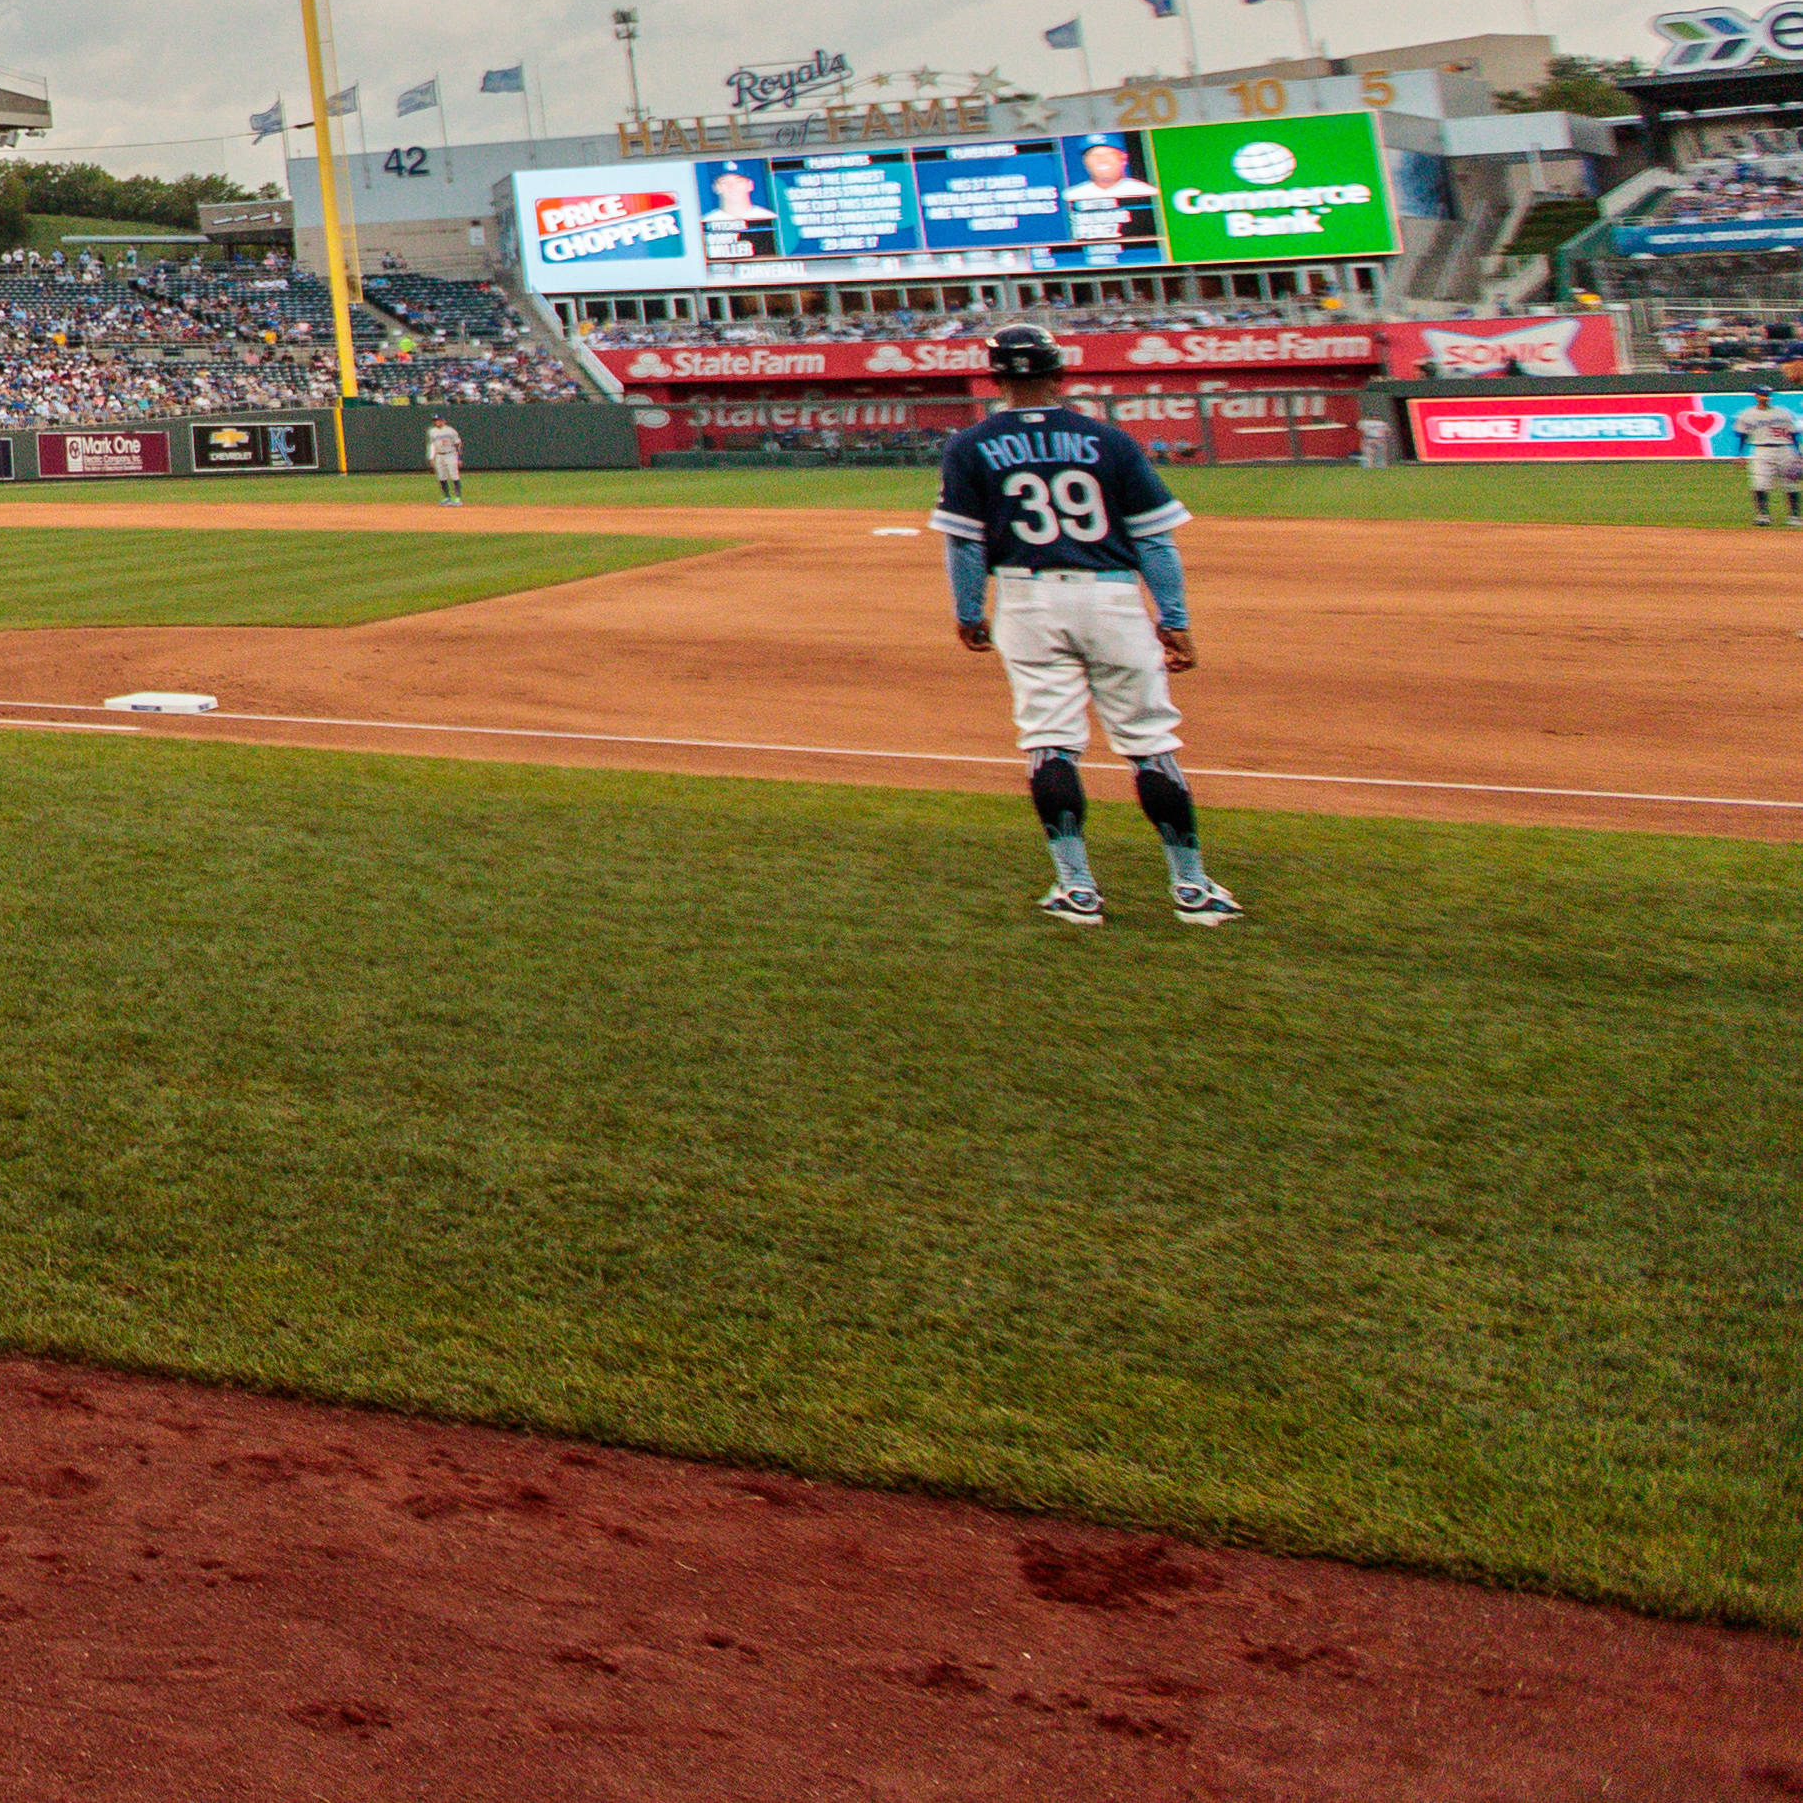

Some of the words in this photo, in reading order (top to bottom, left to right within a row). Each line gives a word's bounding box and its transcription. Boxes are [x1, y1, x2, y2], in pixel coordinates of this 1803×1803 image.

[726, 49, 849, 108] Royals
[1227, 78, 1287, 116] 10
[1362, 69, 1396, 107] 5
[1113, 87, 1179, 126] 20
[616, 113, 762, 158] HALL
[774, 113, 818, 151] of
[826, 97, 991, 143] FAME
[384, 146, 431, 178] 42
[542, 195, 627, 232] PRICE
[1173, 183, 1371, 214] Commerce
[544, 214, 680, 261] CHOPPER
[1226, 209, 1325, 237] Bank
[672, 349, 825, 378] StateFarm
[1182, 334, 1372, 365] StateFarm
[1443, 341, 1562, 366] SONIC
[83, 436, 113, 455] Mark
[114, 436, 141, 454] One
[269, 427, 296, 466] KC
[1438, 419, 1520, 439] PRICE
[1531, 417, 1662, 439] CHOPPER
[976, 431, 1100, 471] HOLLINS
[1002, 469, 1109, 545] 39
